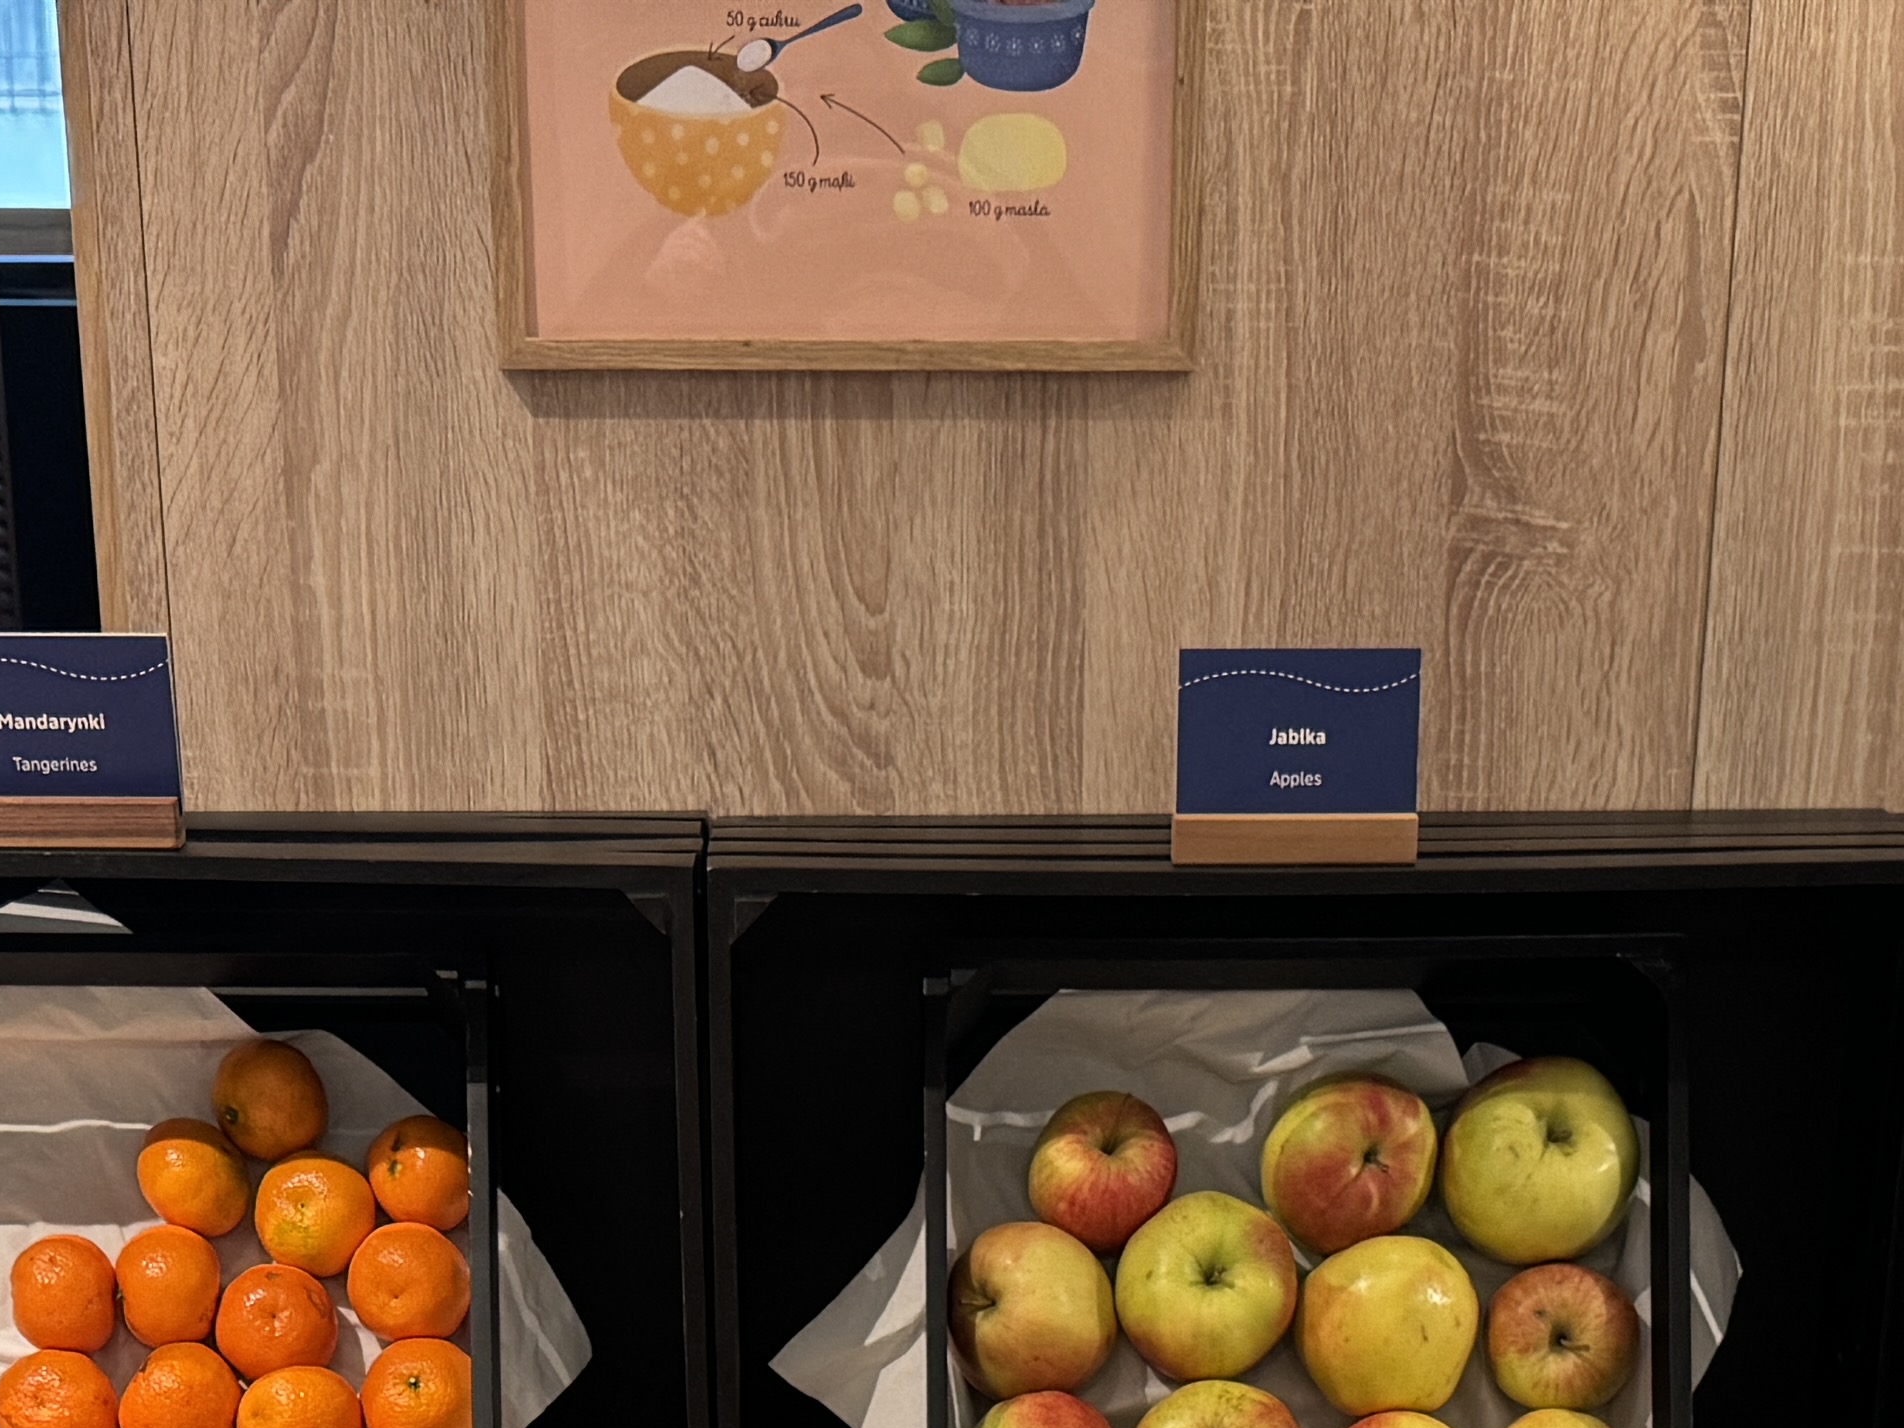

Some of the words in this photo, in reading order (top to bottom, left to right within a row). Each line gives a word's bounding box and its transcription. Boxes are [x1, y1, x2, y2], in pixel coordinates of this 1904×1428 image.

[726, 10, 744, 27] 50
[747, 16, 757, 32] g
[783, 171, 805, 188] 150
[808, 177, 817, 193] g
[969, 200, 992, 216] 100
[994, 205, 1002, 221] g
[12, 755, 98, 775] Tangerines
[1269, 770, 1323, 789] Apples
